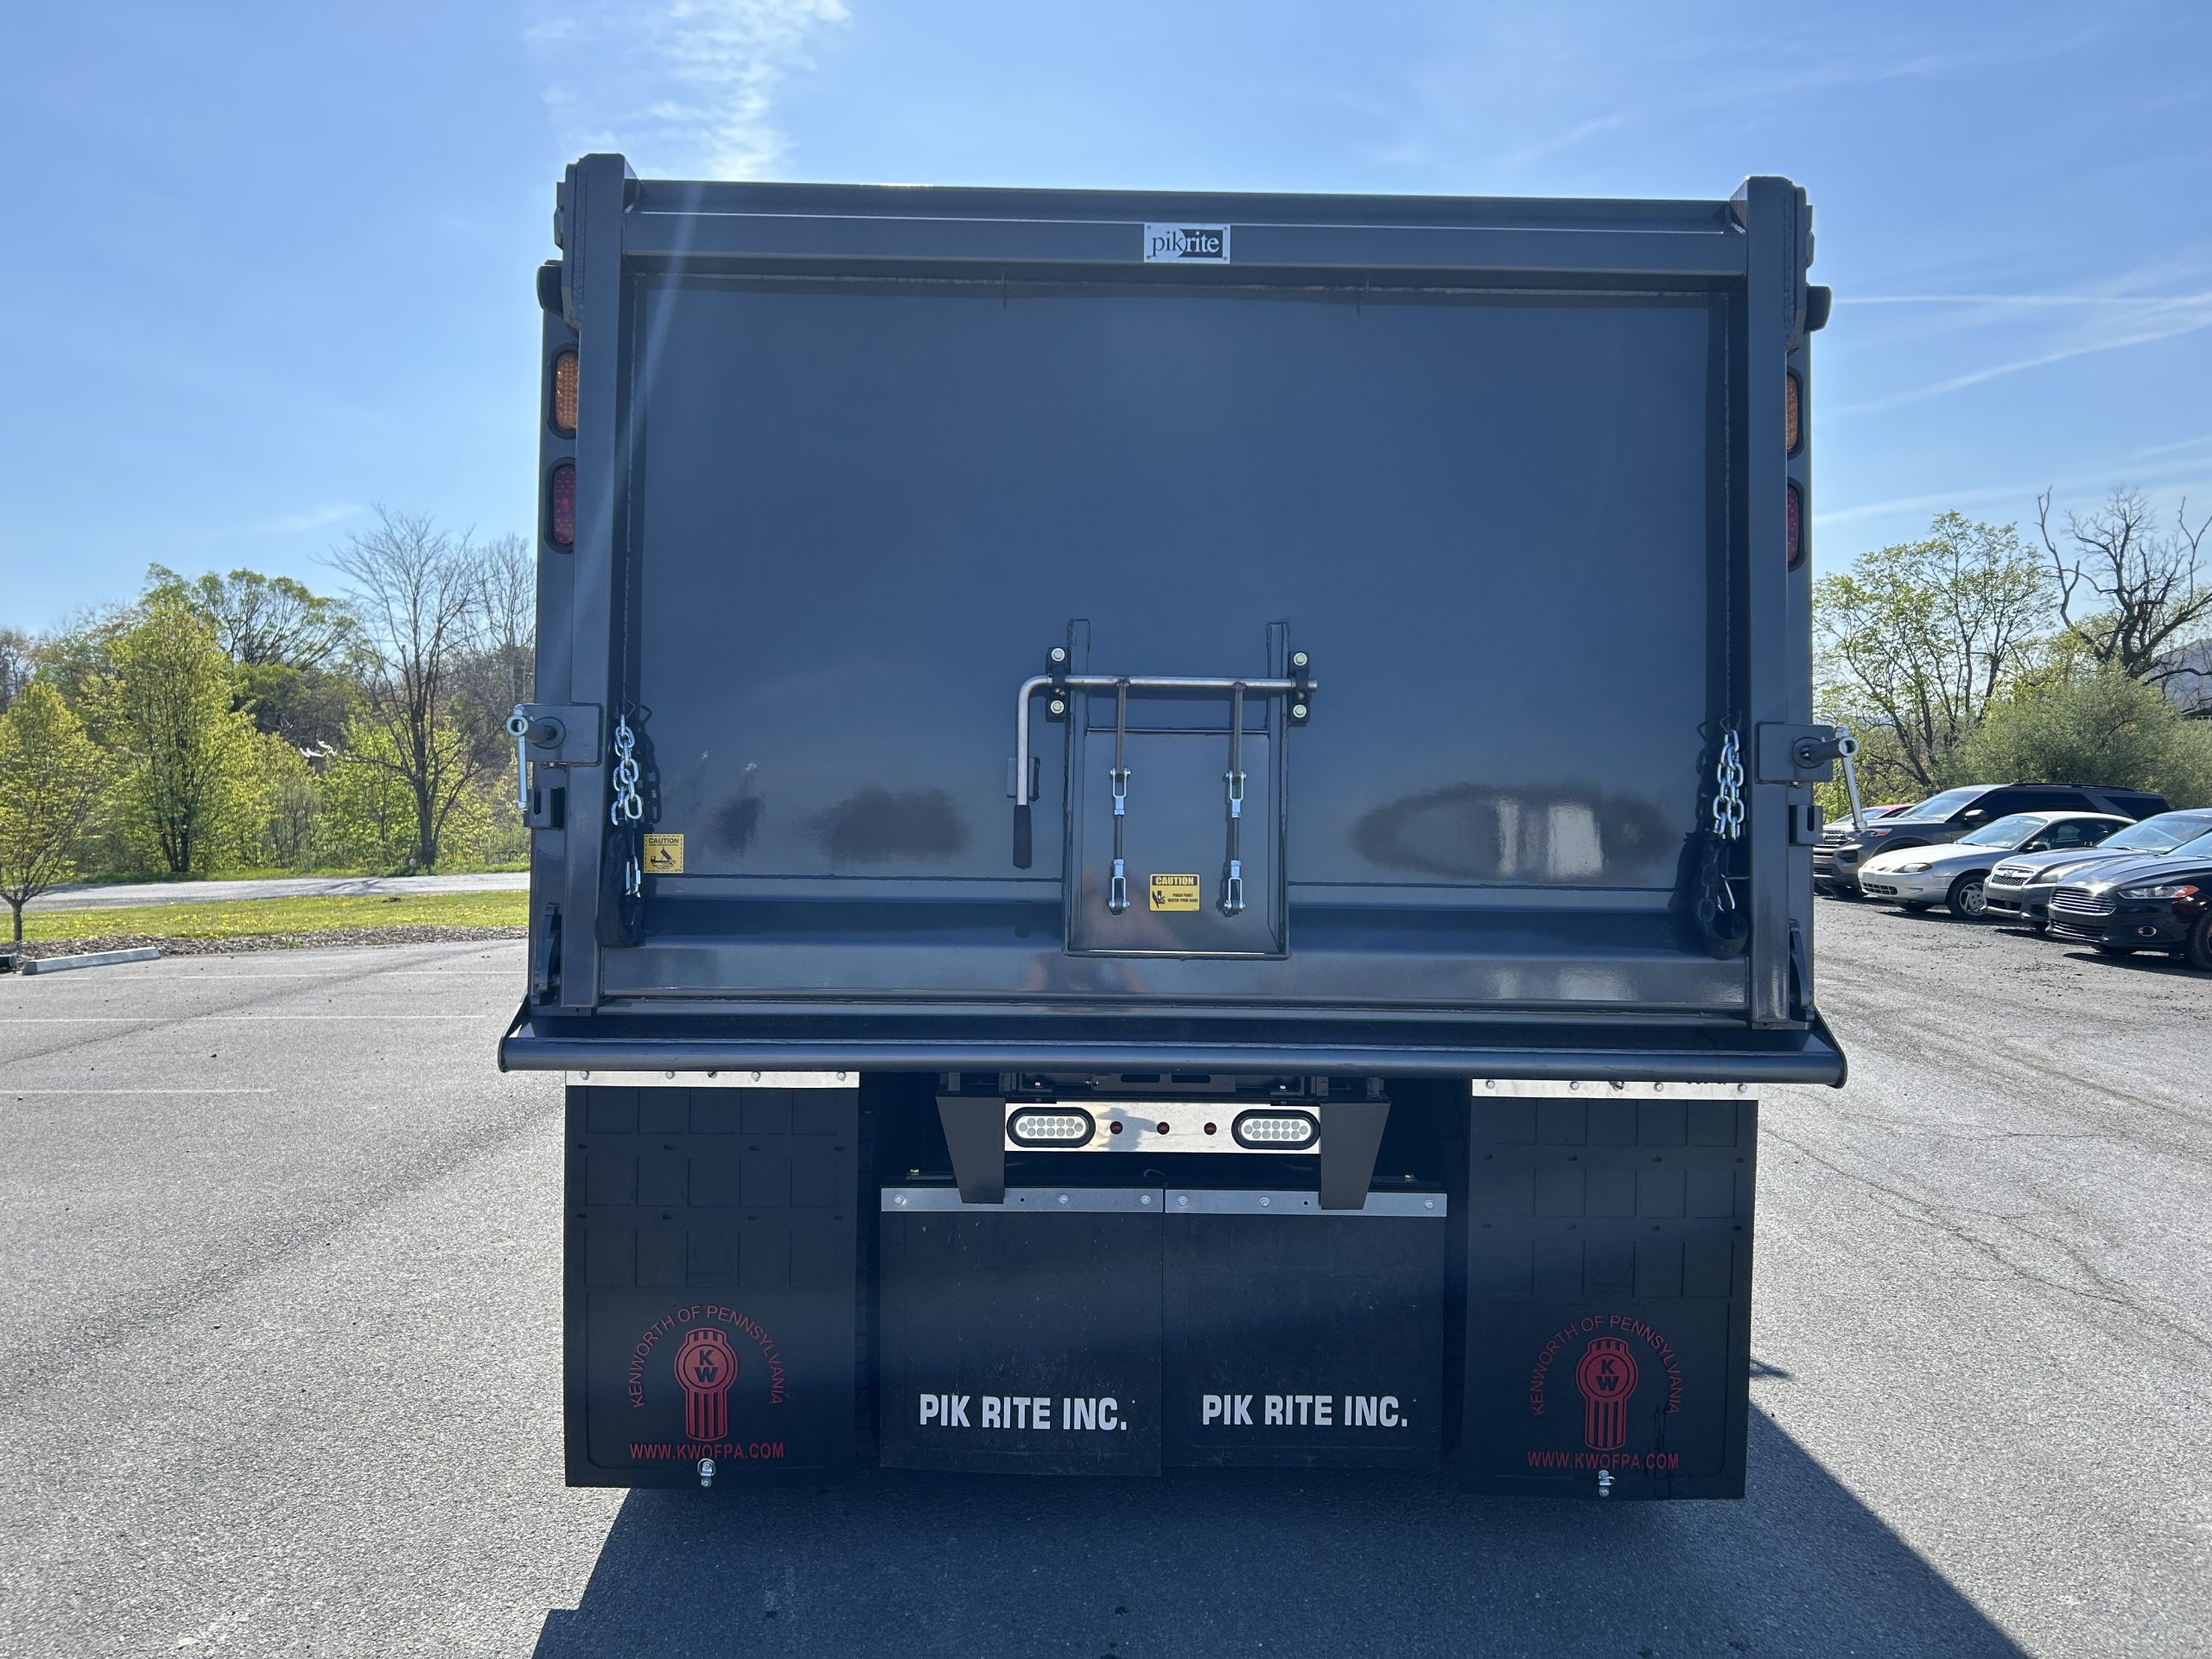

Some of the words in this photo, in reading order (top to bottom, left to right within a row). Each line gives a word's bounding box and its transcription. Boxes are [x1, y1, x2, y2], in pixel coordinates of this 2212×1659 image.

[1155, 876, 1194, 885] CAUTION
[628, 1314, 677, 1408] KENWORTH
[677, 1306, 702, 1323] OF
[706, 1305, 785, 1405] PENNSYLVANIA
[1529, 1324, 1579, 1416] KENWORTH
[1580, 1315, 1605, 1332] OF
[1609, 1314, 1683, 1414] PENNSYLVANIA
[919, 1394, 971, 1427] PIK
[982, 1395, 1051, 1430] RITE
[1063, 1397, 1128, 1431] INC.
[1202, 1395, 1254, 1426] PIK
[1264, 1395, 1333, 1426] RITE
[1344, 1395, 1408, 1427] INC.
[629, 1442, 785, 1459] WWW.KWOFPA.COM
[1527, 1451, 1680, 1469] WWW.KWOFPA.COM
